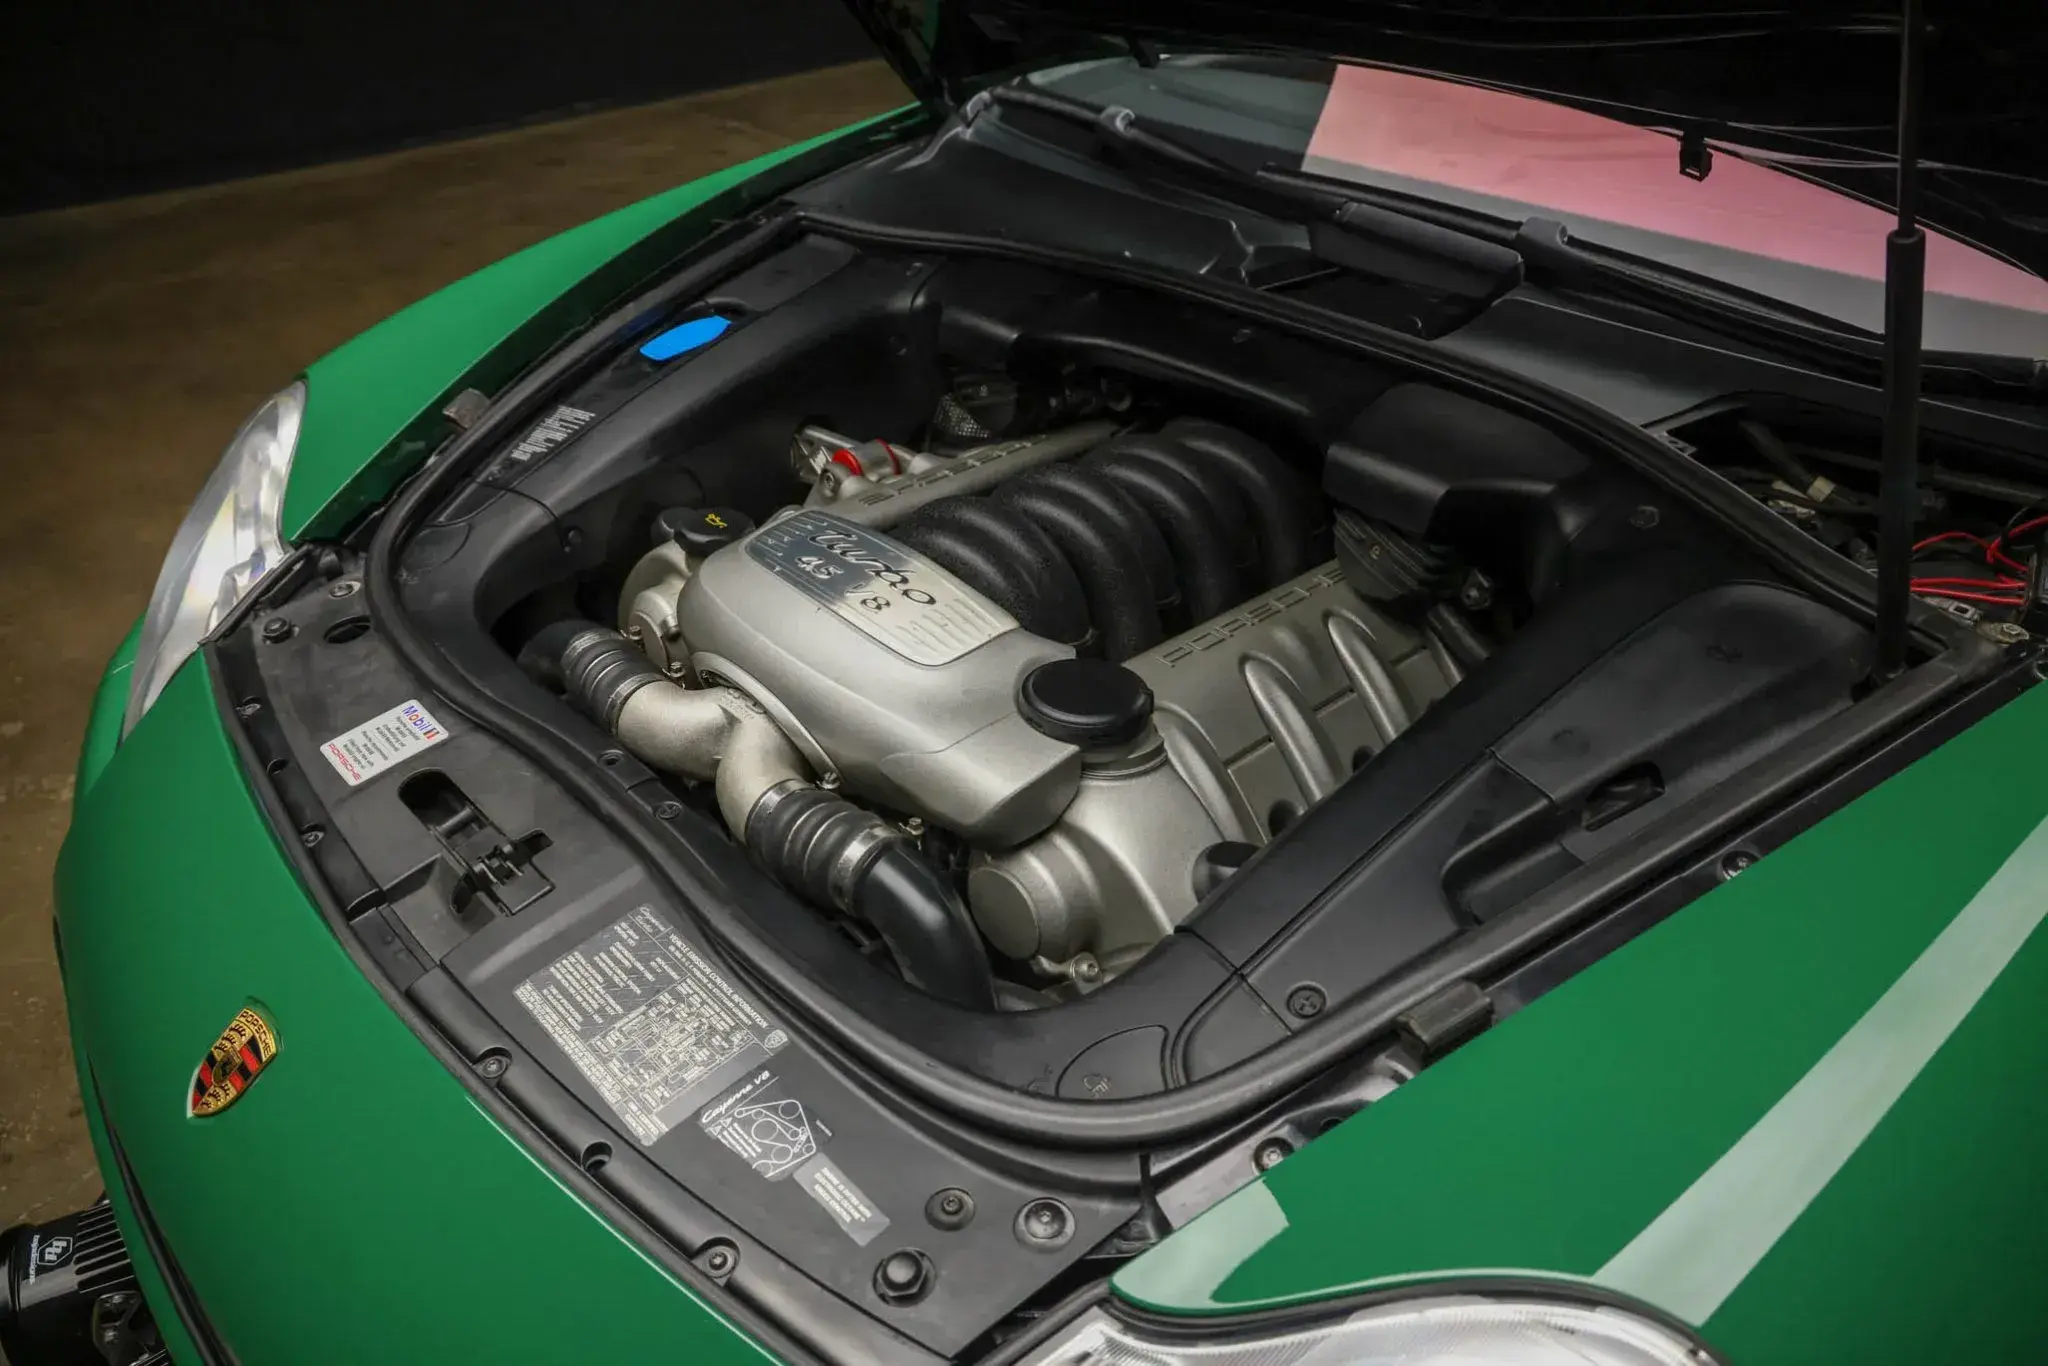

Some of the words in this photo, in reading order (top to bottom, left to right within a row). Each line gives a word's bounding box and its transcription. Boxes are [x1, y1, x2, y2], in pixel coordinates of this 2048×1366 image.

[844, 580, 891, 614] V8
[1156, 567, 1348, 668] PORSCHE
[402, 705, 432, 731] Mobil
[328, 743, 363, 782] PORSCHE
[669, 932, 691, 954] VEHICLE
[686, 950, 713, 976] EMISSION
[709, 972, 734, 997] CONTROL
[731, 993, 769, 1029] INFORMATION
[240, 1010, 272, 1060] PORSCHE
[702, 1084, 754, 1123] Cayenne
[754, 1070, 770, 1085] V8
